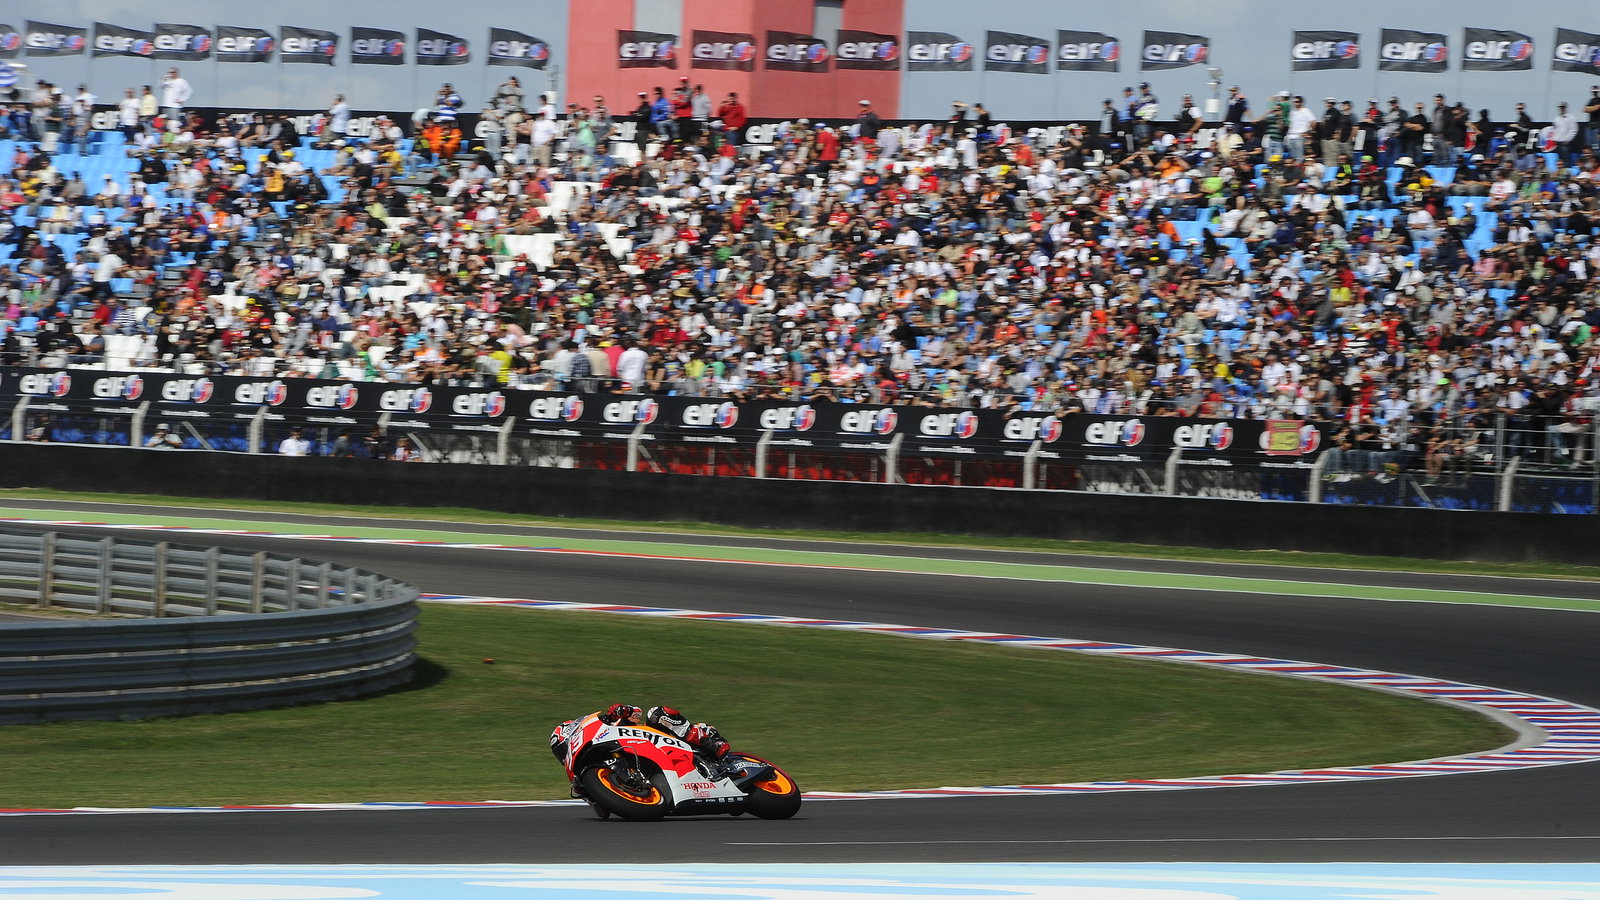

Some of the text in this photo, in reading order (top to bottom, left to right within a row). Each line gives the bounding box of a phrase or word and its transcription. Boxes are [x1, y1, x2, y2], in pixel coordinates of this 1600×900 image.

[19, 373, 52, 395] elf
[93, 375, 126, 398] elf
[162, 379, 195, 401] elf
[234, 383, 268, 404] elf
[306, 386, 339, 407] elf
[380, 390, 413, 411] elf
[453, 393, 487, 415] elf
[530, 397, 565, 419] elf
[603, 400, 639, 423] elf
[683, 403, 719, 426] elf
[760, 407, 796, 429] elf
[841, 410, 878, 433] elf
[920, 413, 957, 436] elf
[1004, 417, 1042, 440] elf
[1085, 421, 1124, 444] elf
[1173, 424, 1211, 448] elf
[683, 782, 717, 792] HONDA
